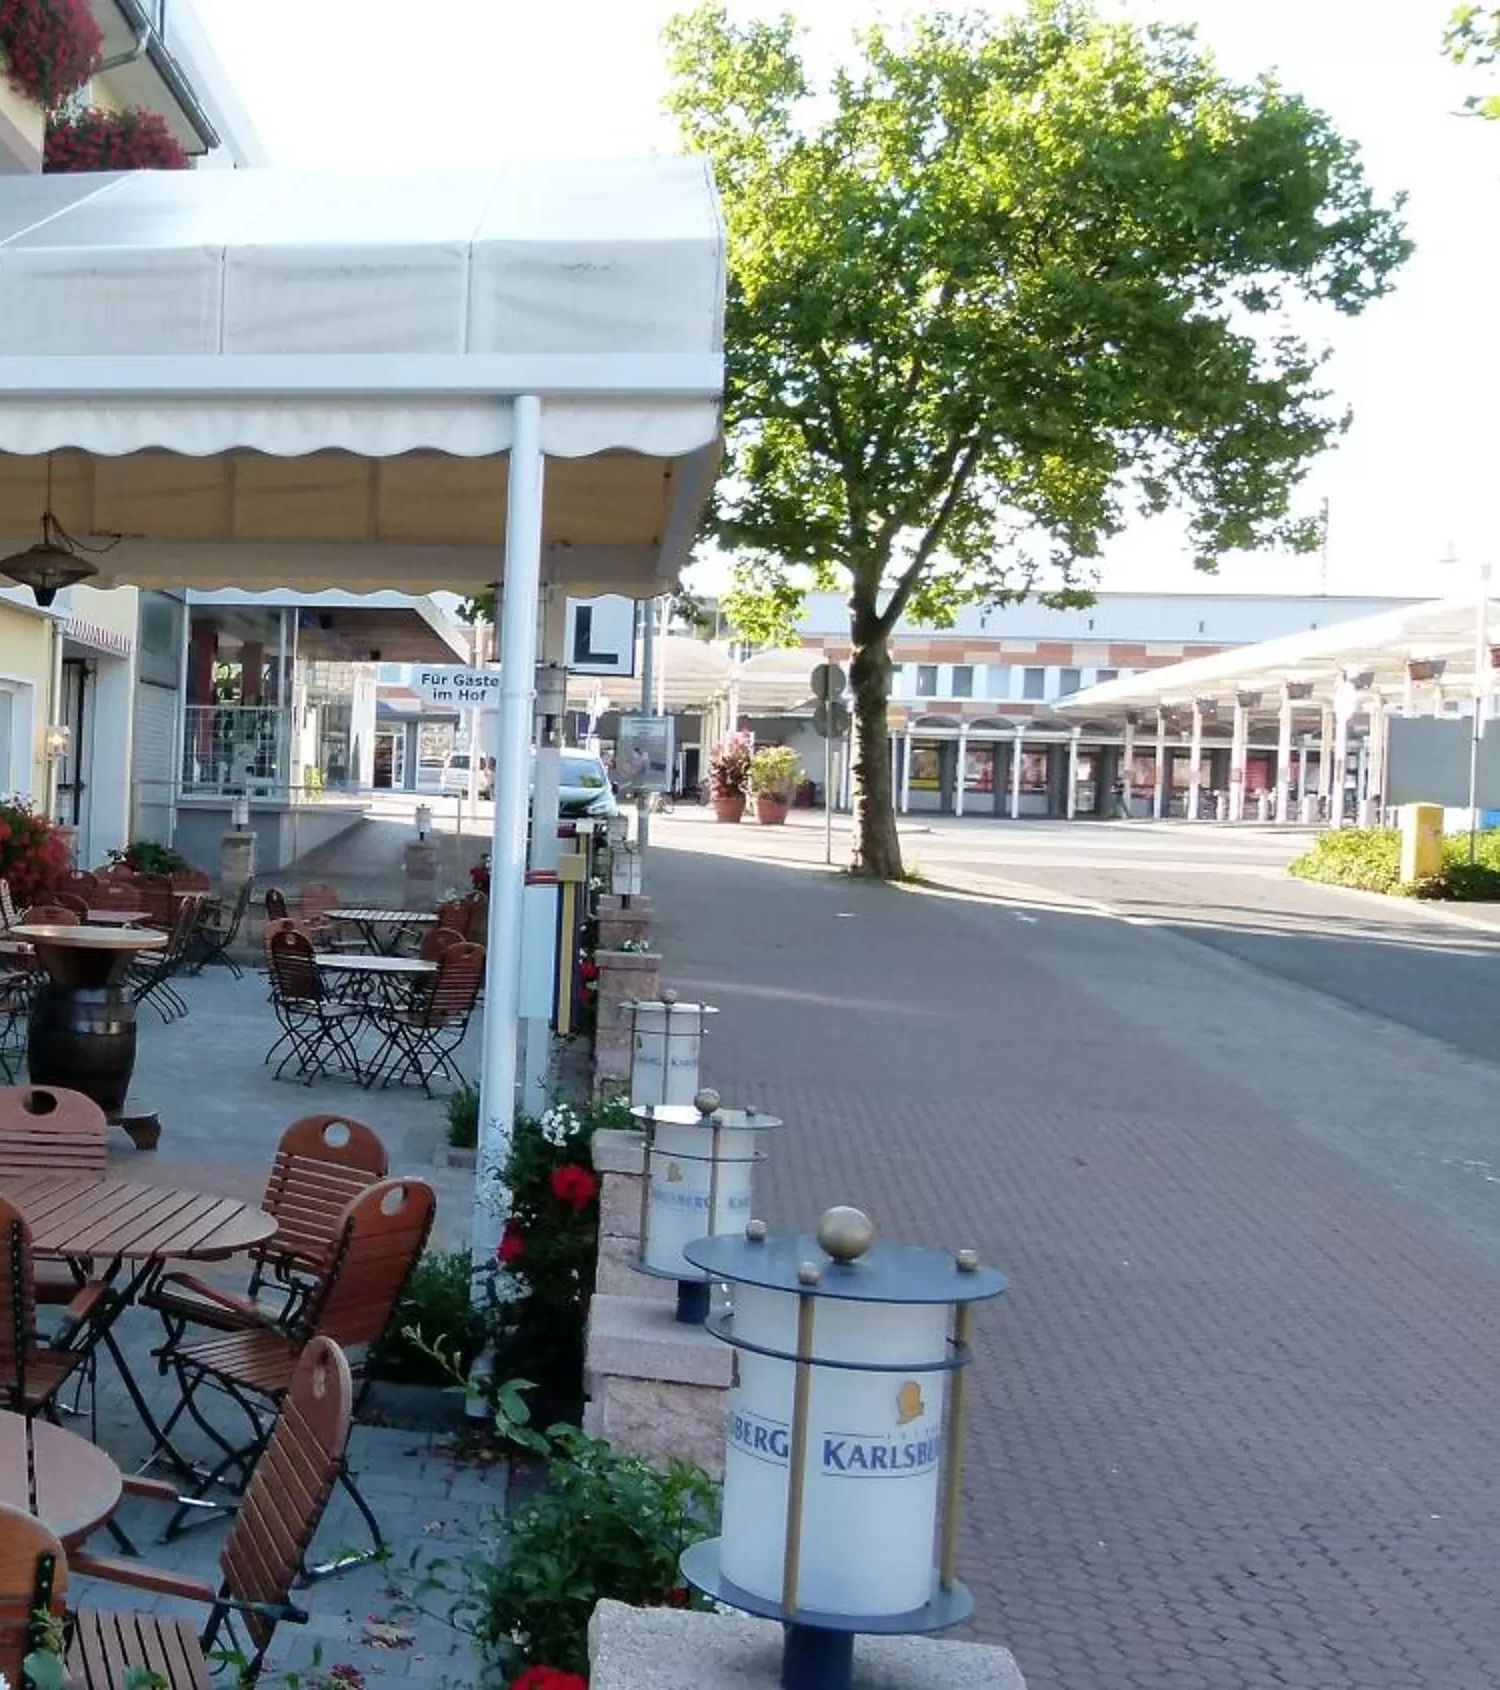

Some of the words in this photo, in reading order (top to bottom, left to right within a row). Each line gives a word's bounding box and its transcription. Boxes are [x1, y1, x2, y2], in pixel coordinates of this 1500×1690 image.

[421, 673, 448, 687] Für
[453, 673, 500, 688] Gäste
[432, 688, 453, 700] im
[459, 688, 488, 701] Hof
